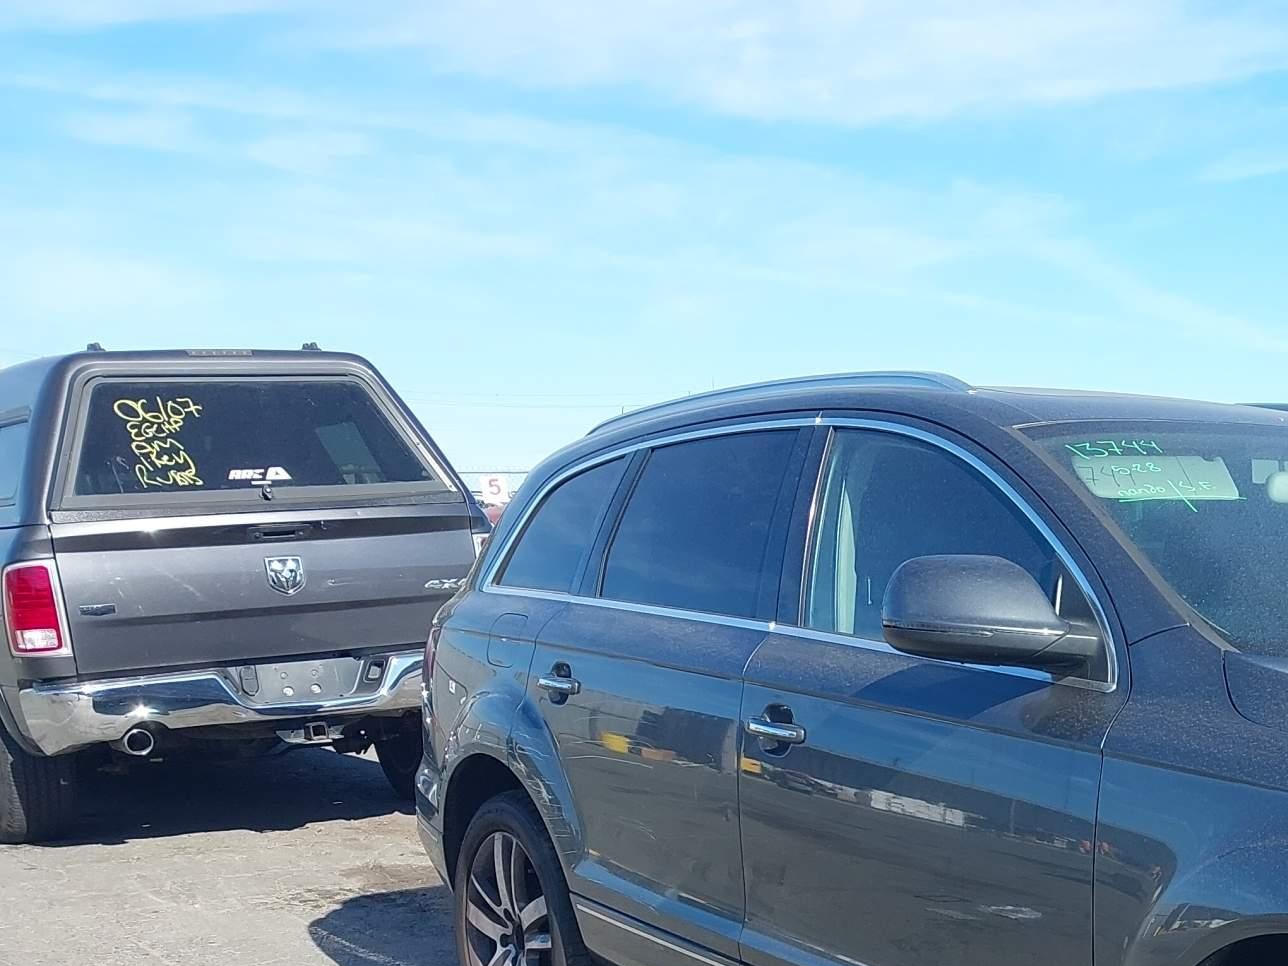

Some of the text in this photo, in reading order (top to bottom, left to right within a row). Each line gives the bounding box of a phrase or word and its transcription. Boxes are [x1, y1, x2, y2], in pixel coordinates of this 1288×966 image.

[113, 396, 203, 423] 06/07
[1064, 439, 1164, 460] 13744
[488, 478, 502, 496] 5
